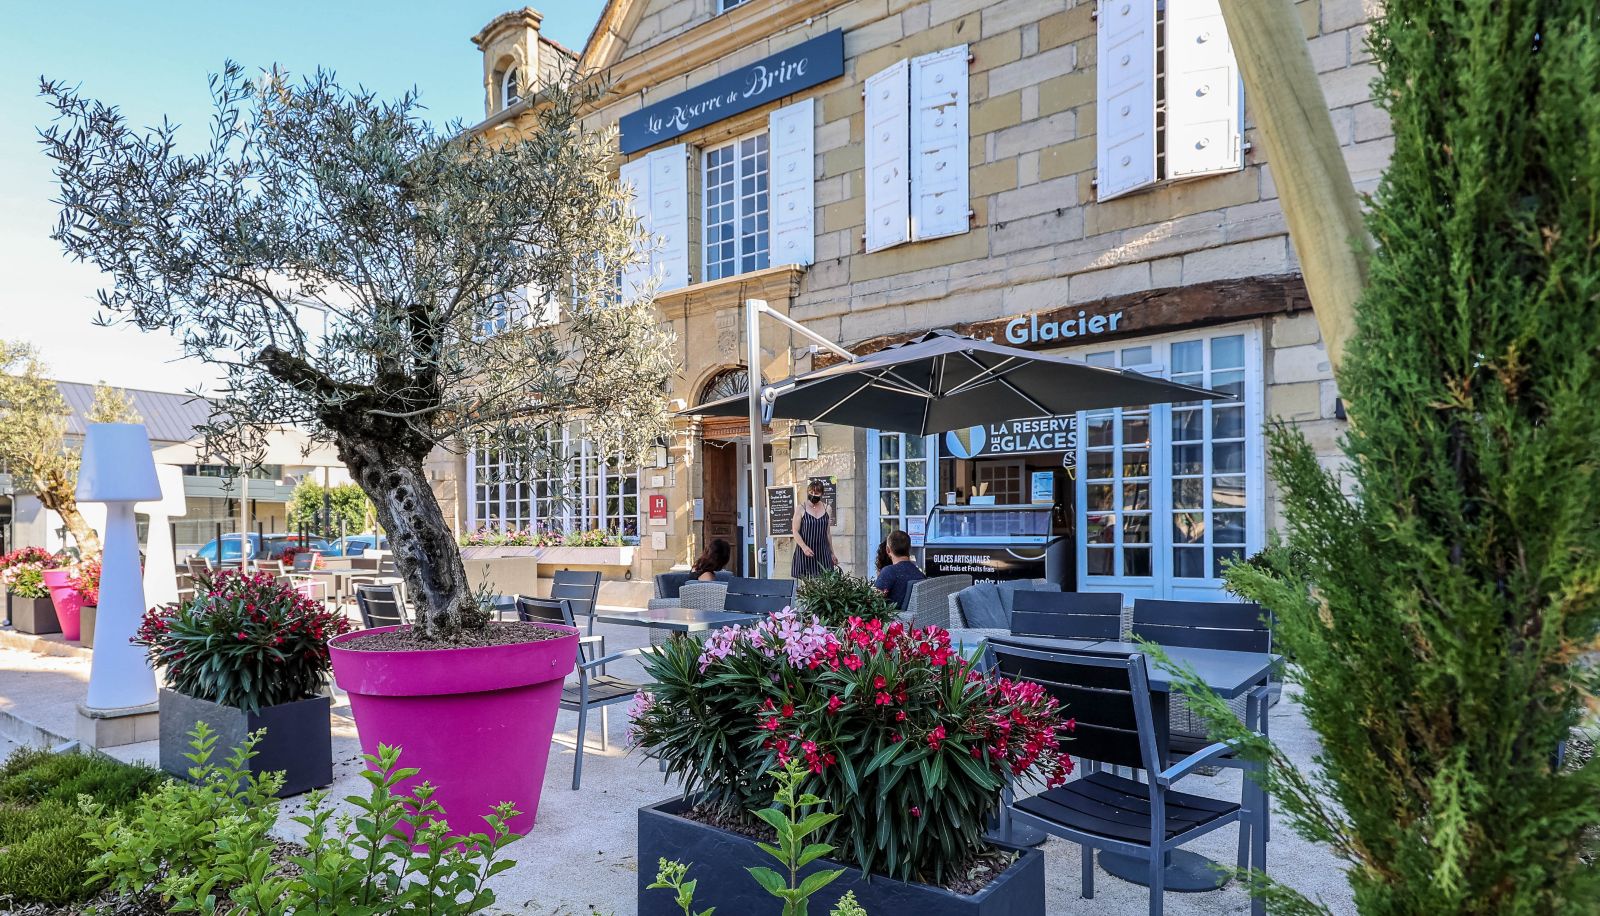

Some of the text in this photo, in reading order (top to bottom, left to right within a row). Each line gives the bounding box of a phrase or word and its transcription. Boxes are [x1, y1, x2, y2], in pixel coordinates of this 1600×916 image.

[645, 113, 662, 134] La
[727, 91, 738, 104] de
[743, 58, 808, 98] Brive
[1005, 309, 1123, 344] Glacier
[990, 417, 1077, 435] LA RESERVE
[991, 431, 1077, 452] DE GLACES
[656, 499, 664, 508] H
[933, 554, 991, 564] GLACES ARTISANALES
